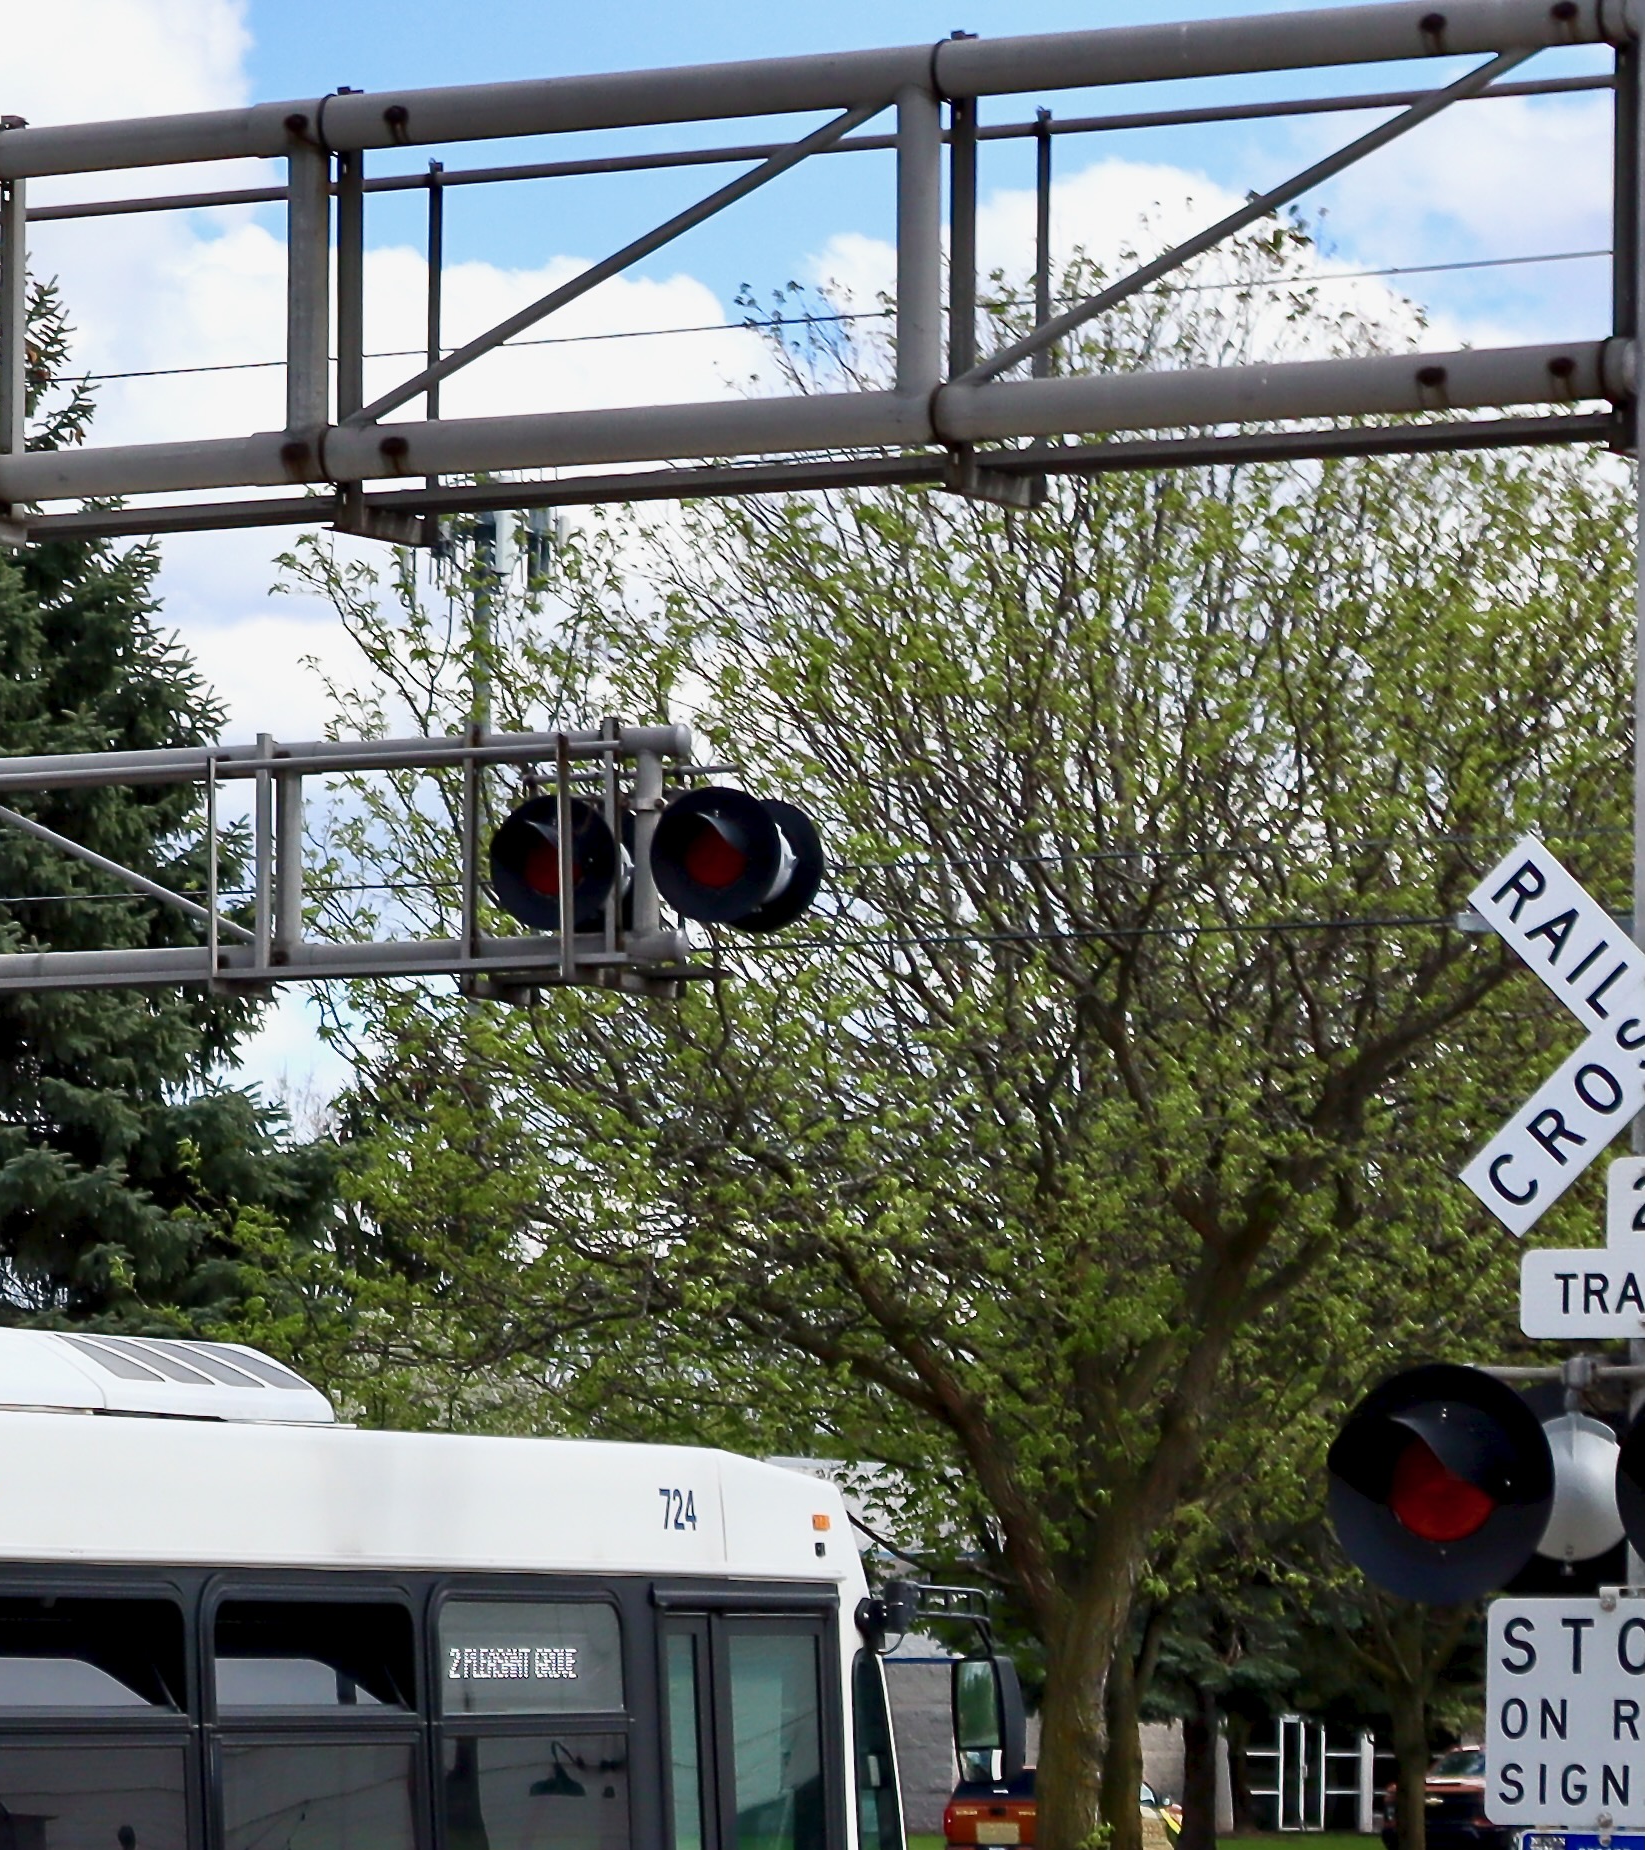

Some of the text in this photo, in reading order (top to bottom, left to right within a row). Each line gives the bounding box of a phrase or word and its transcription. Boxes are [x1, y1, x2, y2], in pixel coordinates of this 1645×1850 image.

[1491, 859, 1628, 1020] RAIL
[1554, 1272, 1645, 1315] TRA
[658, 1488, 698, 1531] 724
[449, 1648, 460, 1678] 2
[1501, 1698, 1567, 1740] ON
